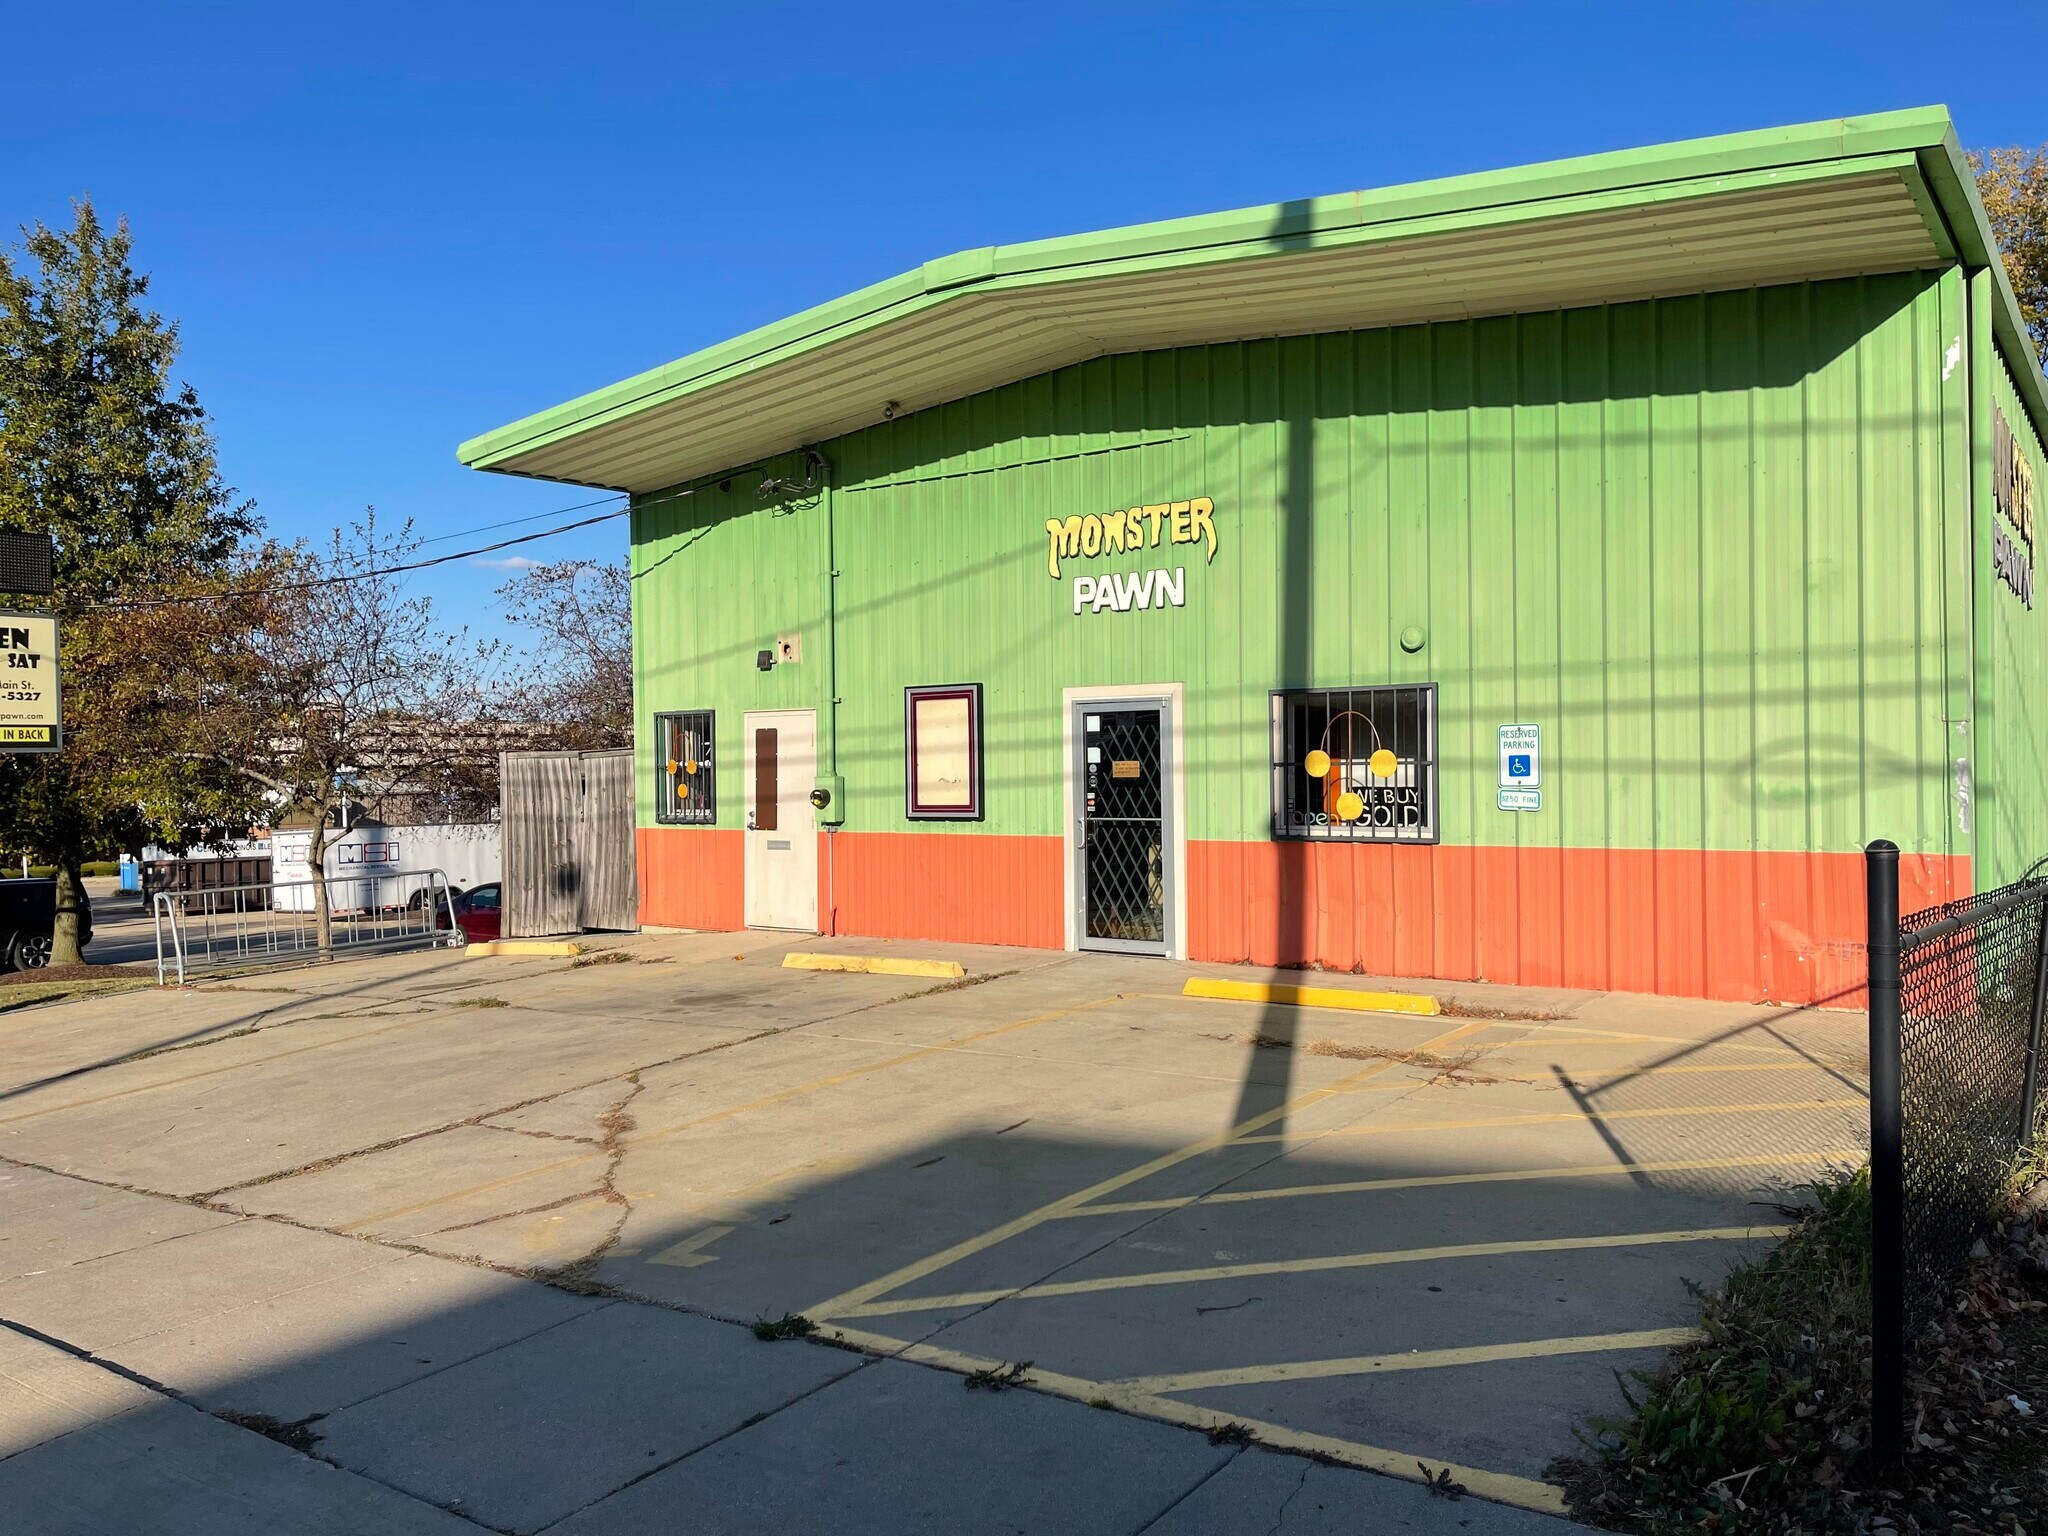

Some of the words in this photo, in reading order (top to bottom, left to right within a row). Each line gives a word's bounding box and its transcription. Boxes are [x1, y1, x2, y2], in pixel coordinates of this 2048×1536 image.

[1045, 496, 1218, 580] MONSTER
[1073, 567, 1185, 615] PAWN
[0, 627, 29, 649] EN
[8, 653, 40, 668] SAT
[21, 681, 34, 690] St.
[4, 730, 14, 739] IN
[19, 730, 43, 739] BACK
[1501, 730, 1538, 738] RESERVED
[1503, 741, 1535, 749] PARKING
[1384, 789, 1418, 803] BUY
[1356, 806, 1418, 827] GOLD
